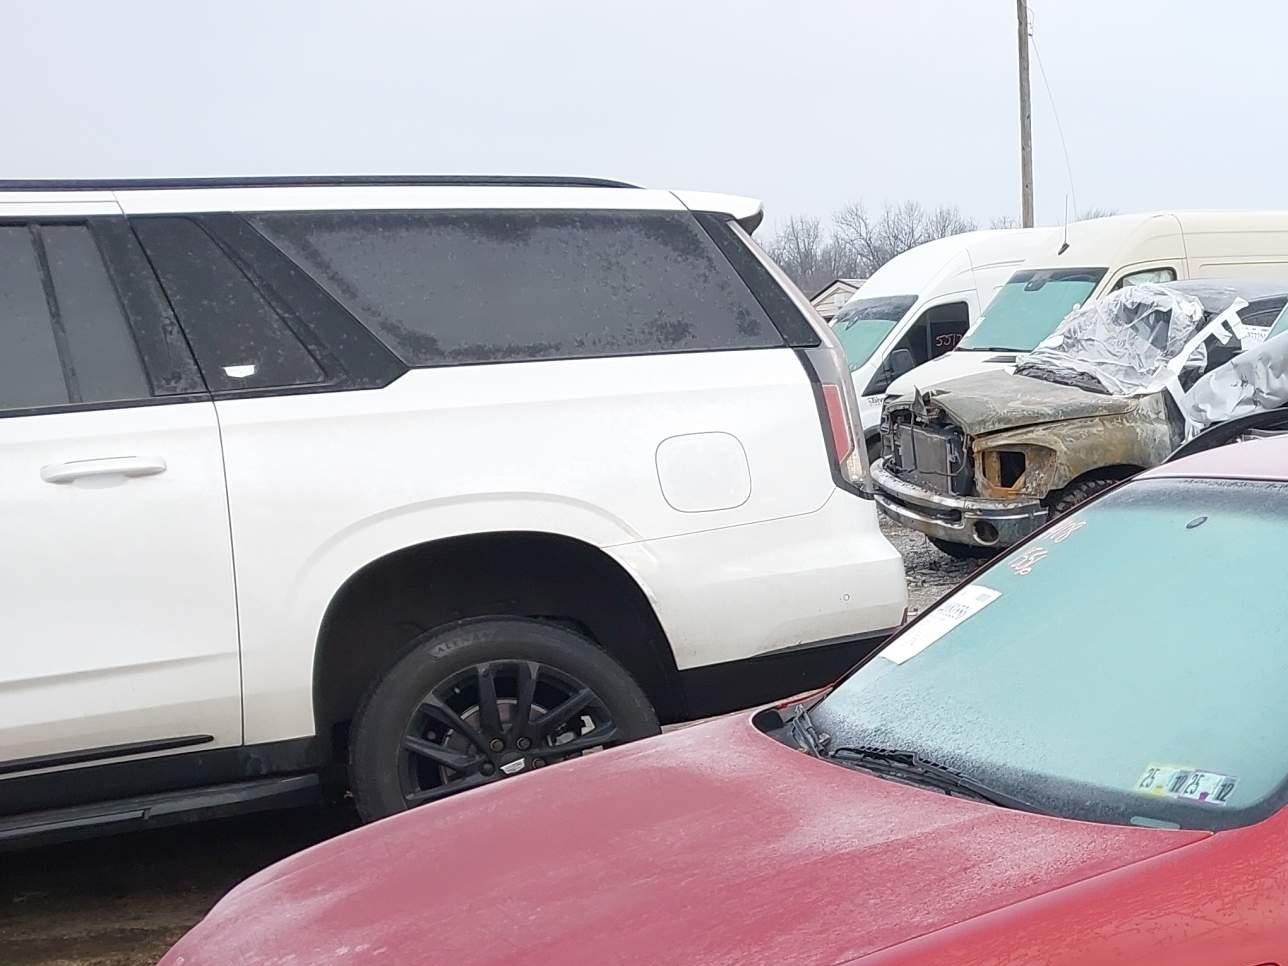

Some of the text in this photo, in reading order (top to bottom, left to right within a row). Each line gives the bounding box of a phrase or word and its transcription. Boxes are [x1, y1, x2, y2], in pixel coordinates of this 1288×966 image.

[1140, 768, 1160, 788] 25
[1184, 774, 1235, 801] 25 12
